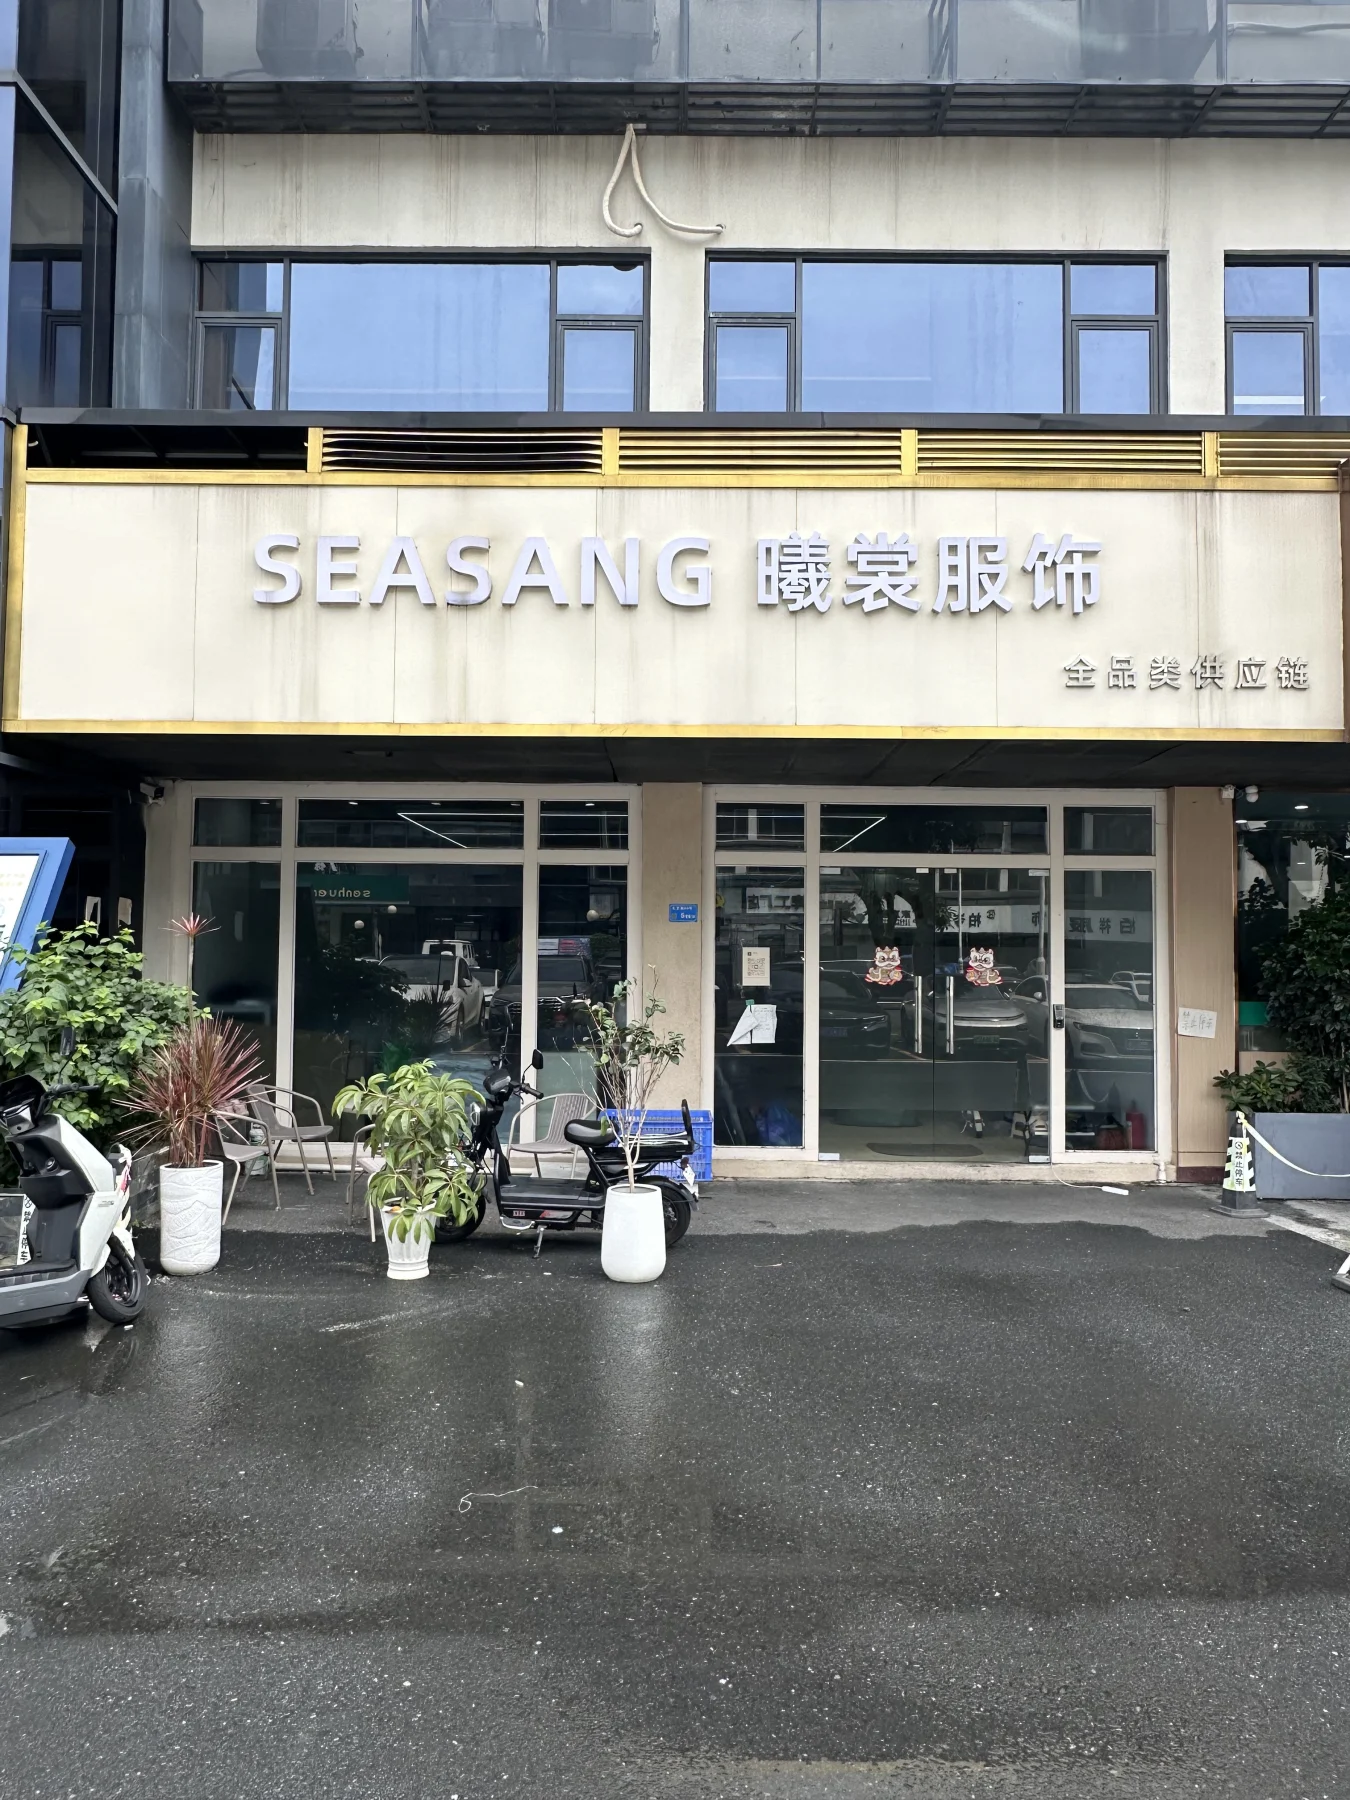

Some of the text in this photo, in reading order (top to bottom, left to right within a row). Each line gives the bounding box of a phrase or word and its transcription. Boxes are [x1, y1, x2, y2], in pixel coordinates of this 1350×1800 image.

[253, 533, 712, 606] SEASANG
[756, 531, 1101, 614] 曦裳服饰
[1063, 654, 1310, 690] 全品类供应链
[1235, 1151, 1244, 1186] 禁止停车
